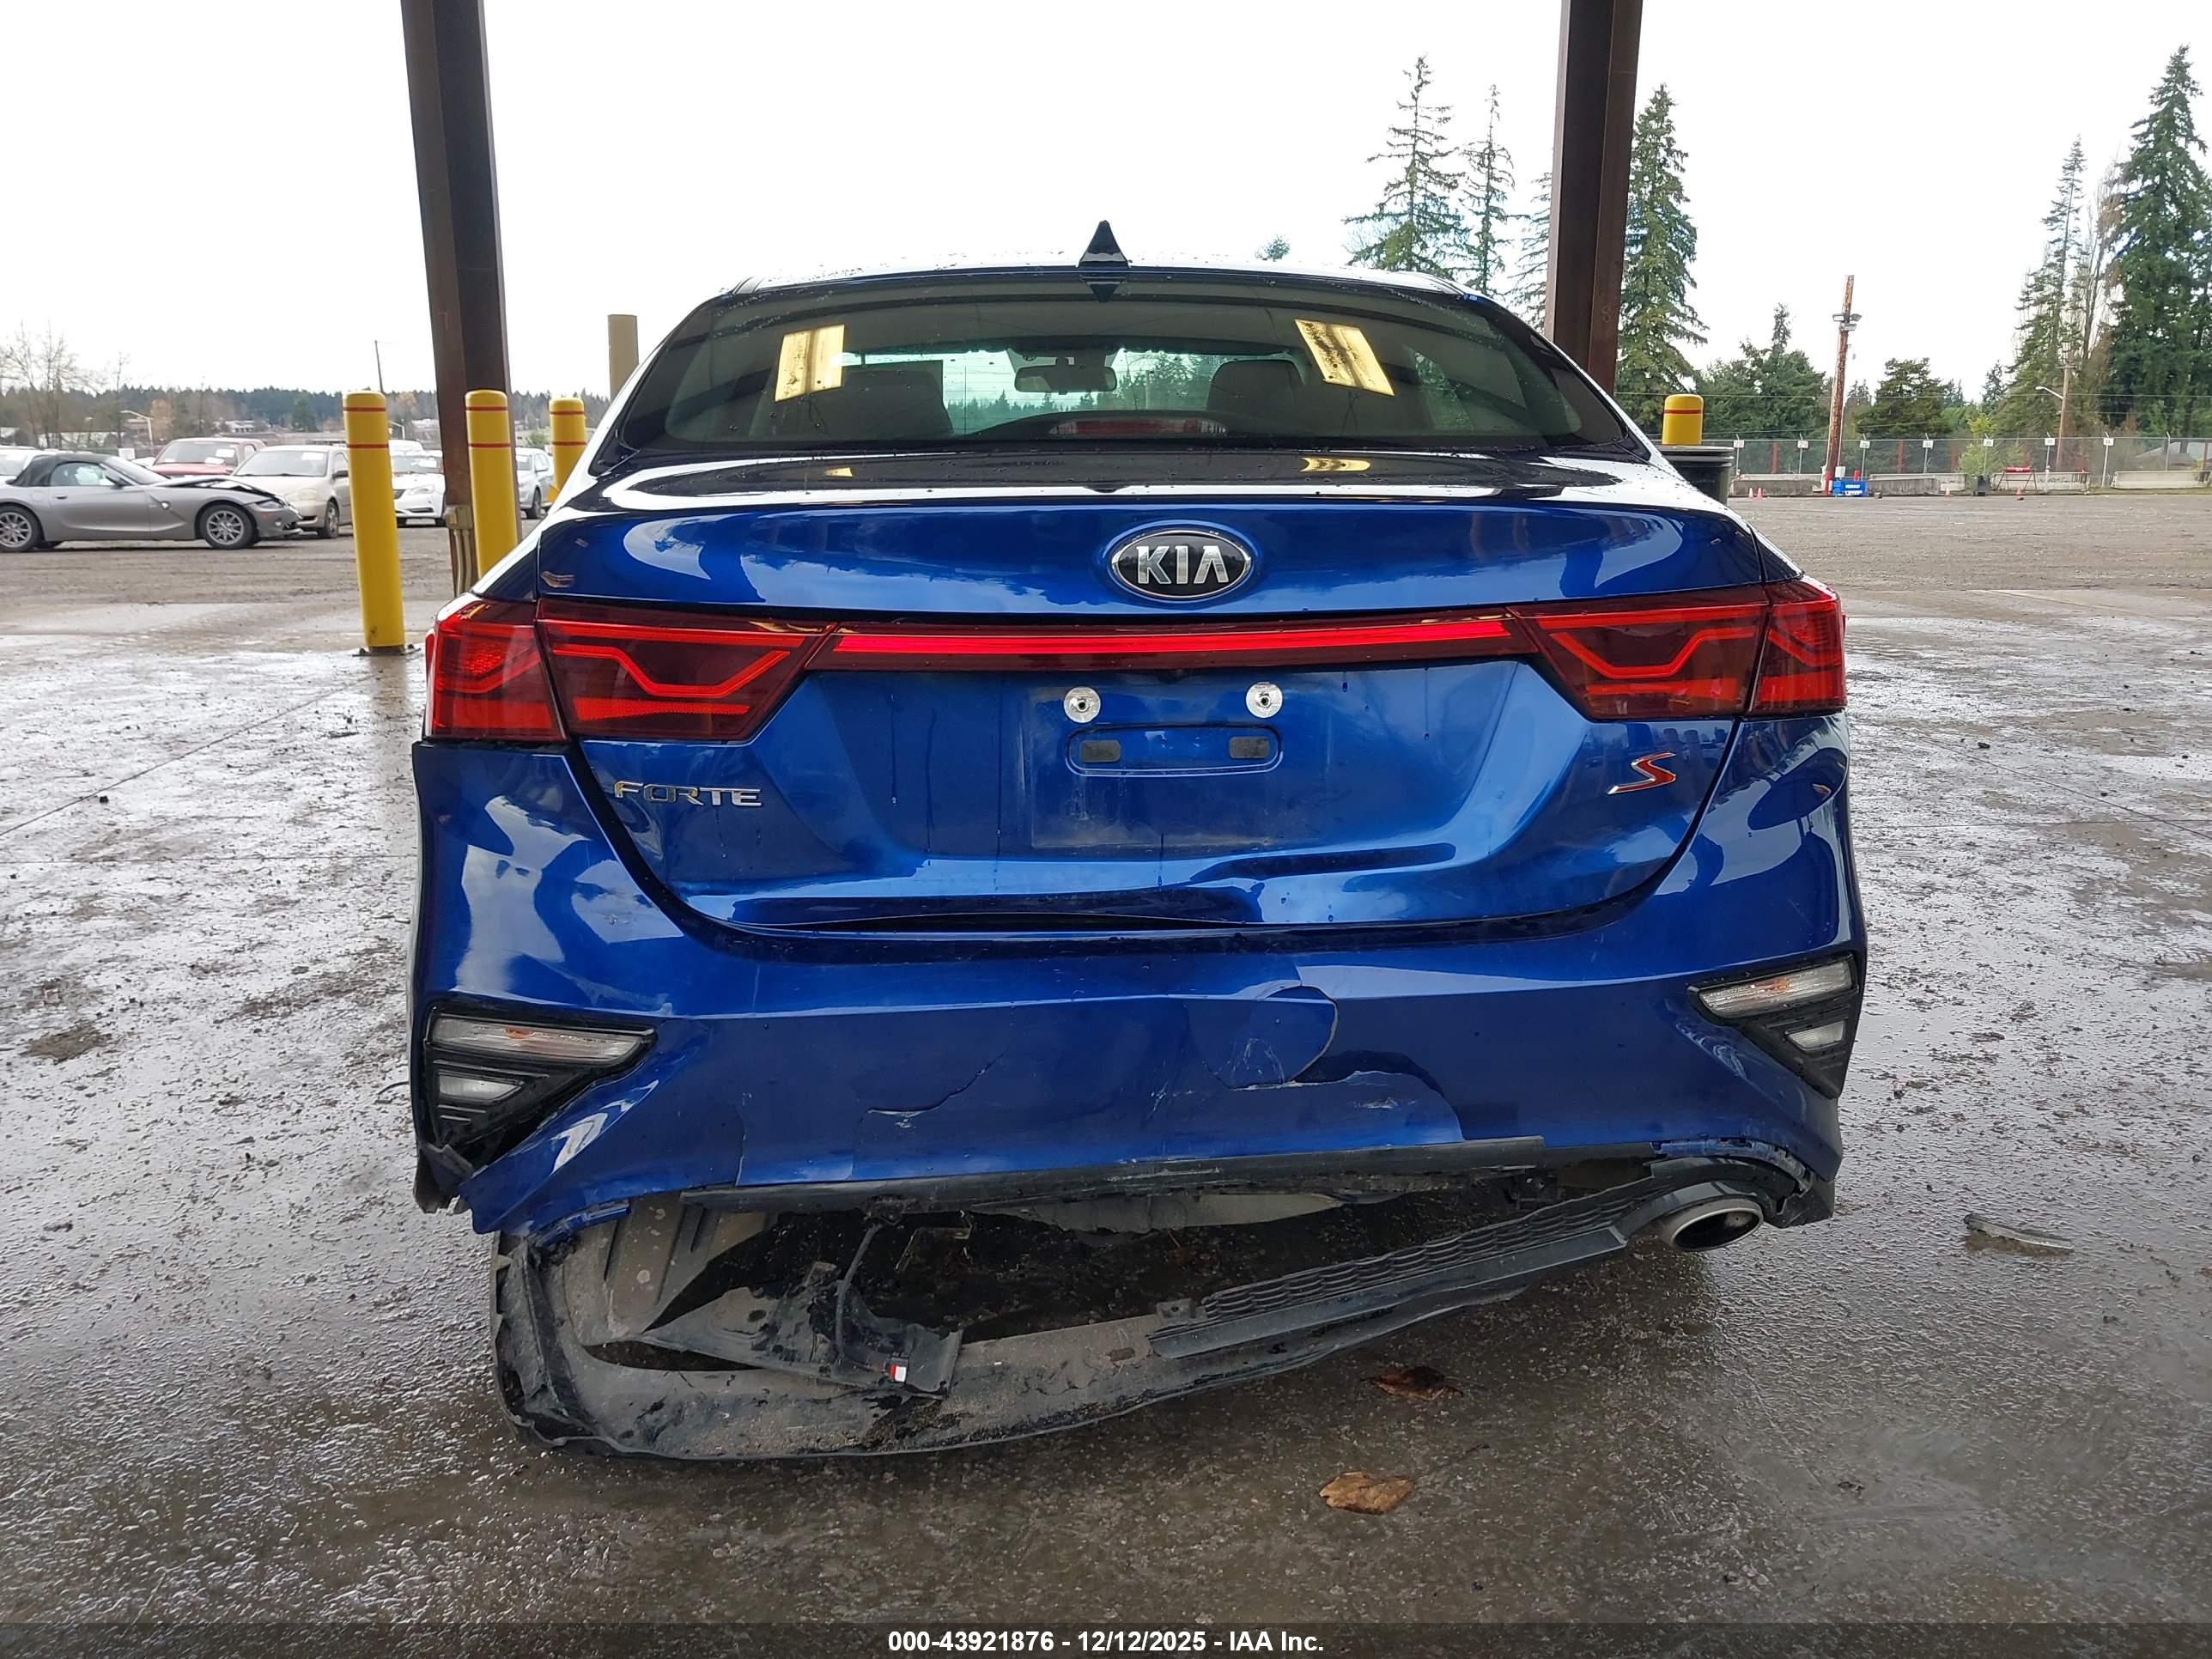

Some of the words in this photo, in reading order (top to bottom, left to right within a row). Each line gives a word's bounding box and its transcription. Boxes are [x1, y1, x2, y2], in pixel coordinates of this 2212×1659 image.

[1135, 545, 1230, 585] KIA
[1607, 751, 1677, 795] S
[614, 781, 763, 806] FORTE
